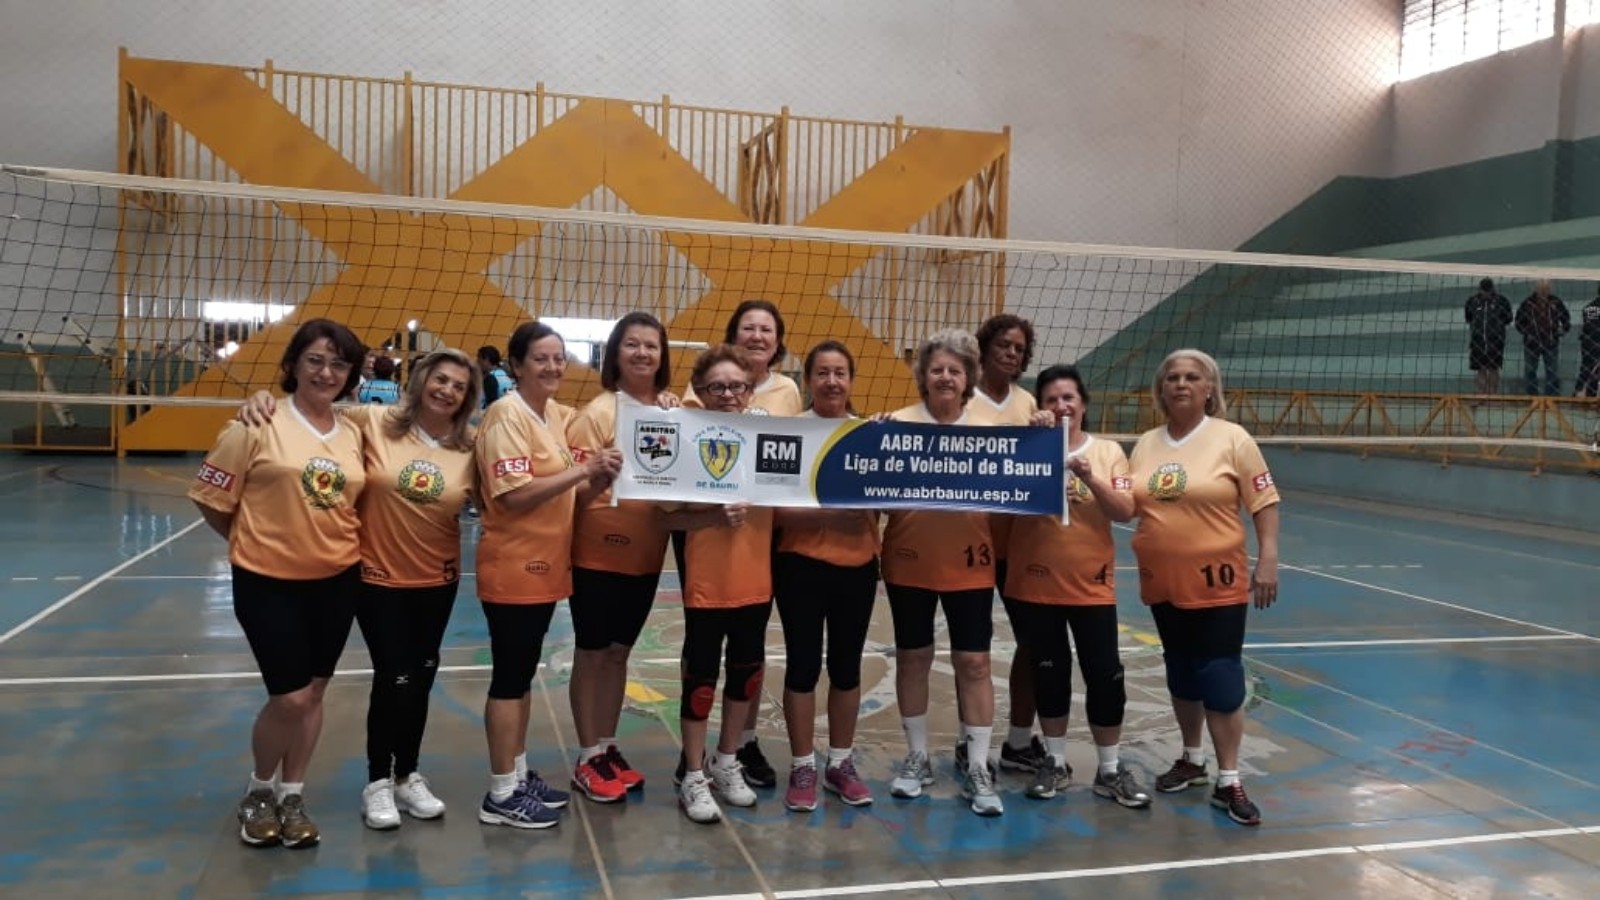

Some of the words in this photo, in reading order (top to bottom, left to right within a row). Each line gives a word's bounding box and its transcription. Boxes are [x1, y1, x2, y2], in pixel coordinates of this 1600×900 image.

[762, 441, 797, 461] RM
[880, 433, 923, 452] AABR
[927, 435, 935, 453] /
[938, 435, 1019, 455] RMSPORT
[497, 458, 530, 476] SESI
[844, 454, 879, 475] Liga
[885, 455, 904, 473] de
[910, 456, 972, 474] Voleibol
[978, 458, 997, 475] de
[1003, 459, 1052, 477] Bauru
[863, 485, 1031, 504] www.aabrbauru.esp.br
[964, 543, 992, 568] 13
[443, 558, 458, 582] 5
[1200, 563, 1236, 588] 10
